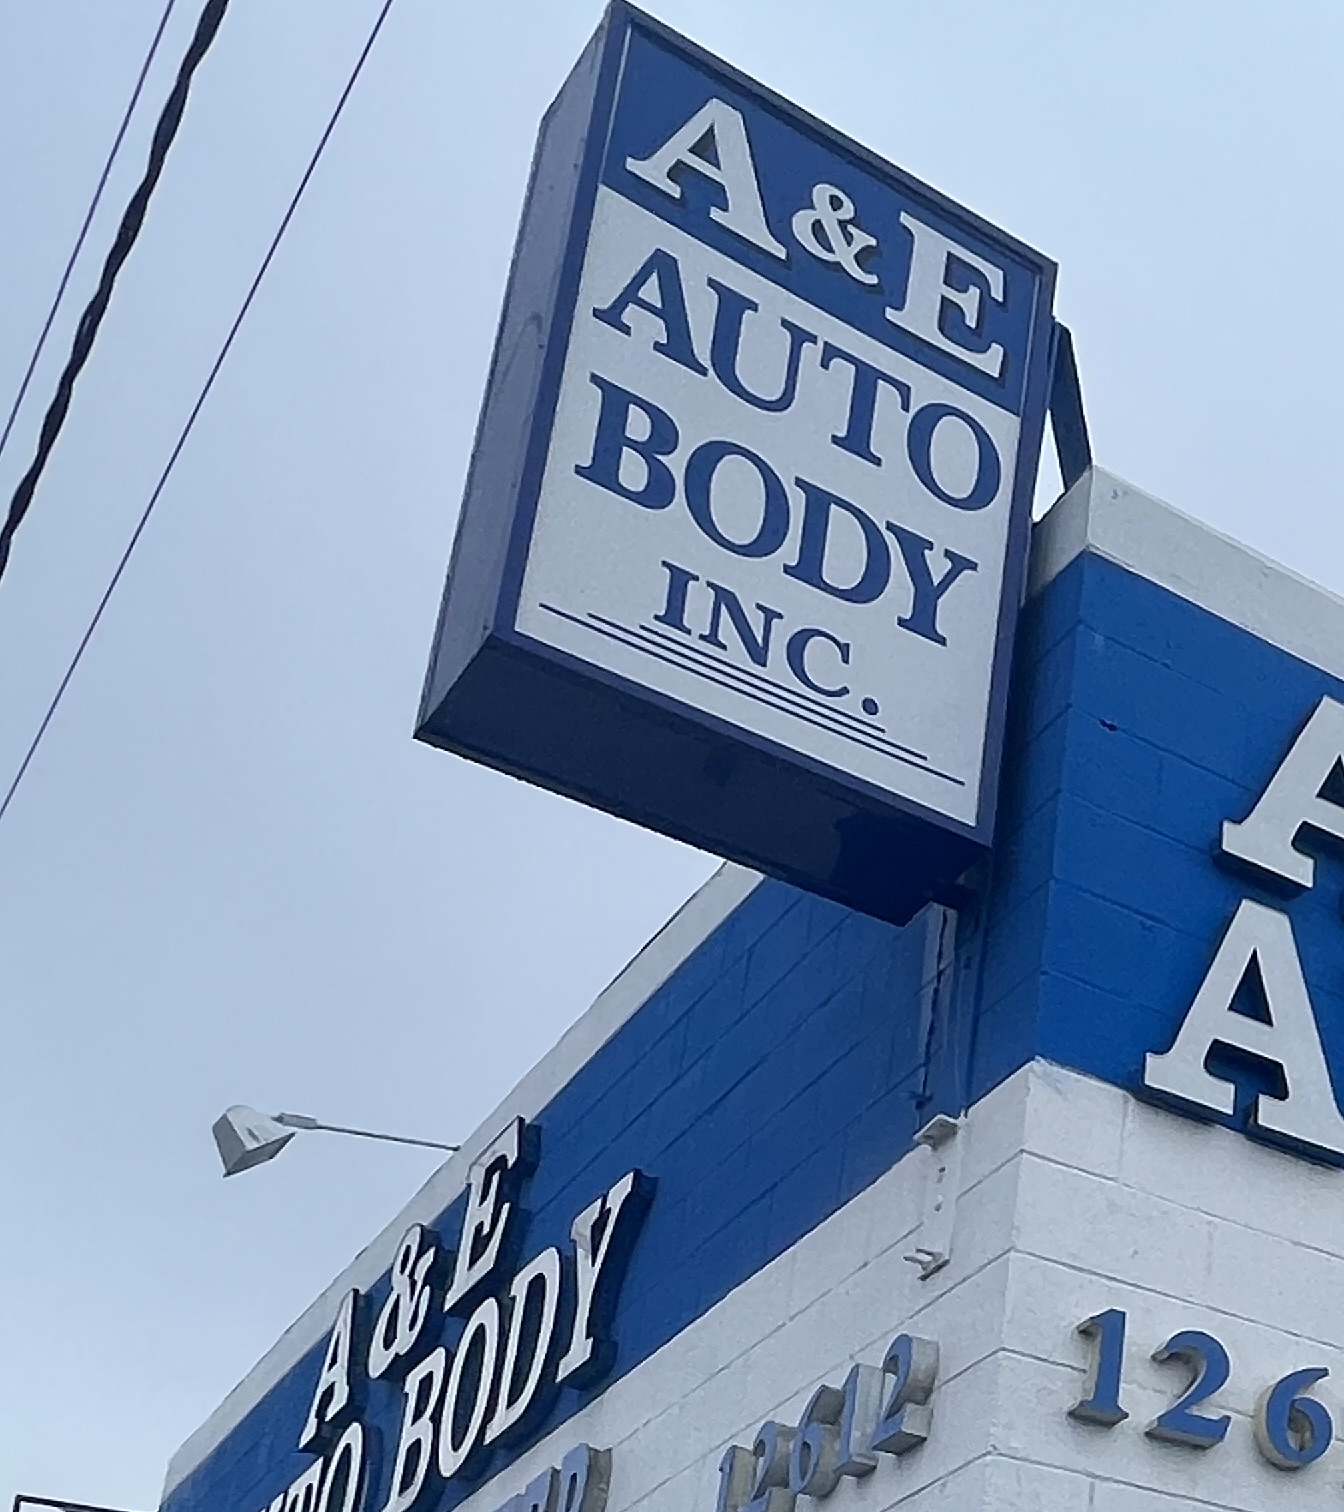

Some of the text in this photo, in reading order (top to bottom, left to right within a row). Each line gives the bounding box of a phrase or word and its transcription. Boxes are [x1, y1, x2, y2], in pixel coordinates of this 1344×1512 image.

[574, 373, 979, 648] BODY
[592, 247, 1001, 513] AUTO
[653, 559, 880, 718] INC.
[297, 1287, 362, 1451] A
[443, 1114, 527, 1315] E
